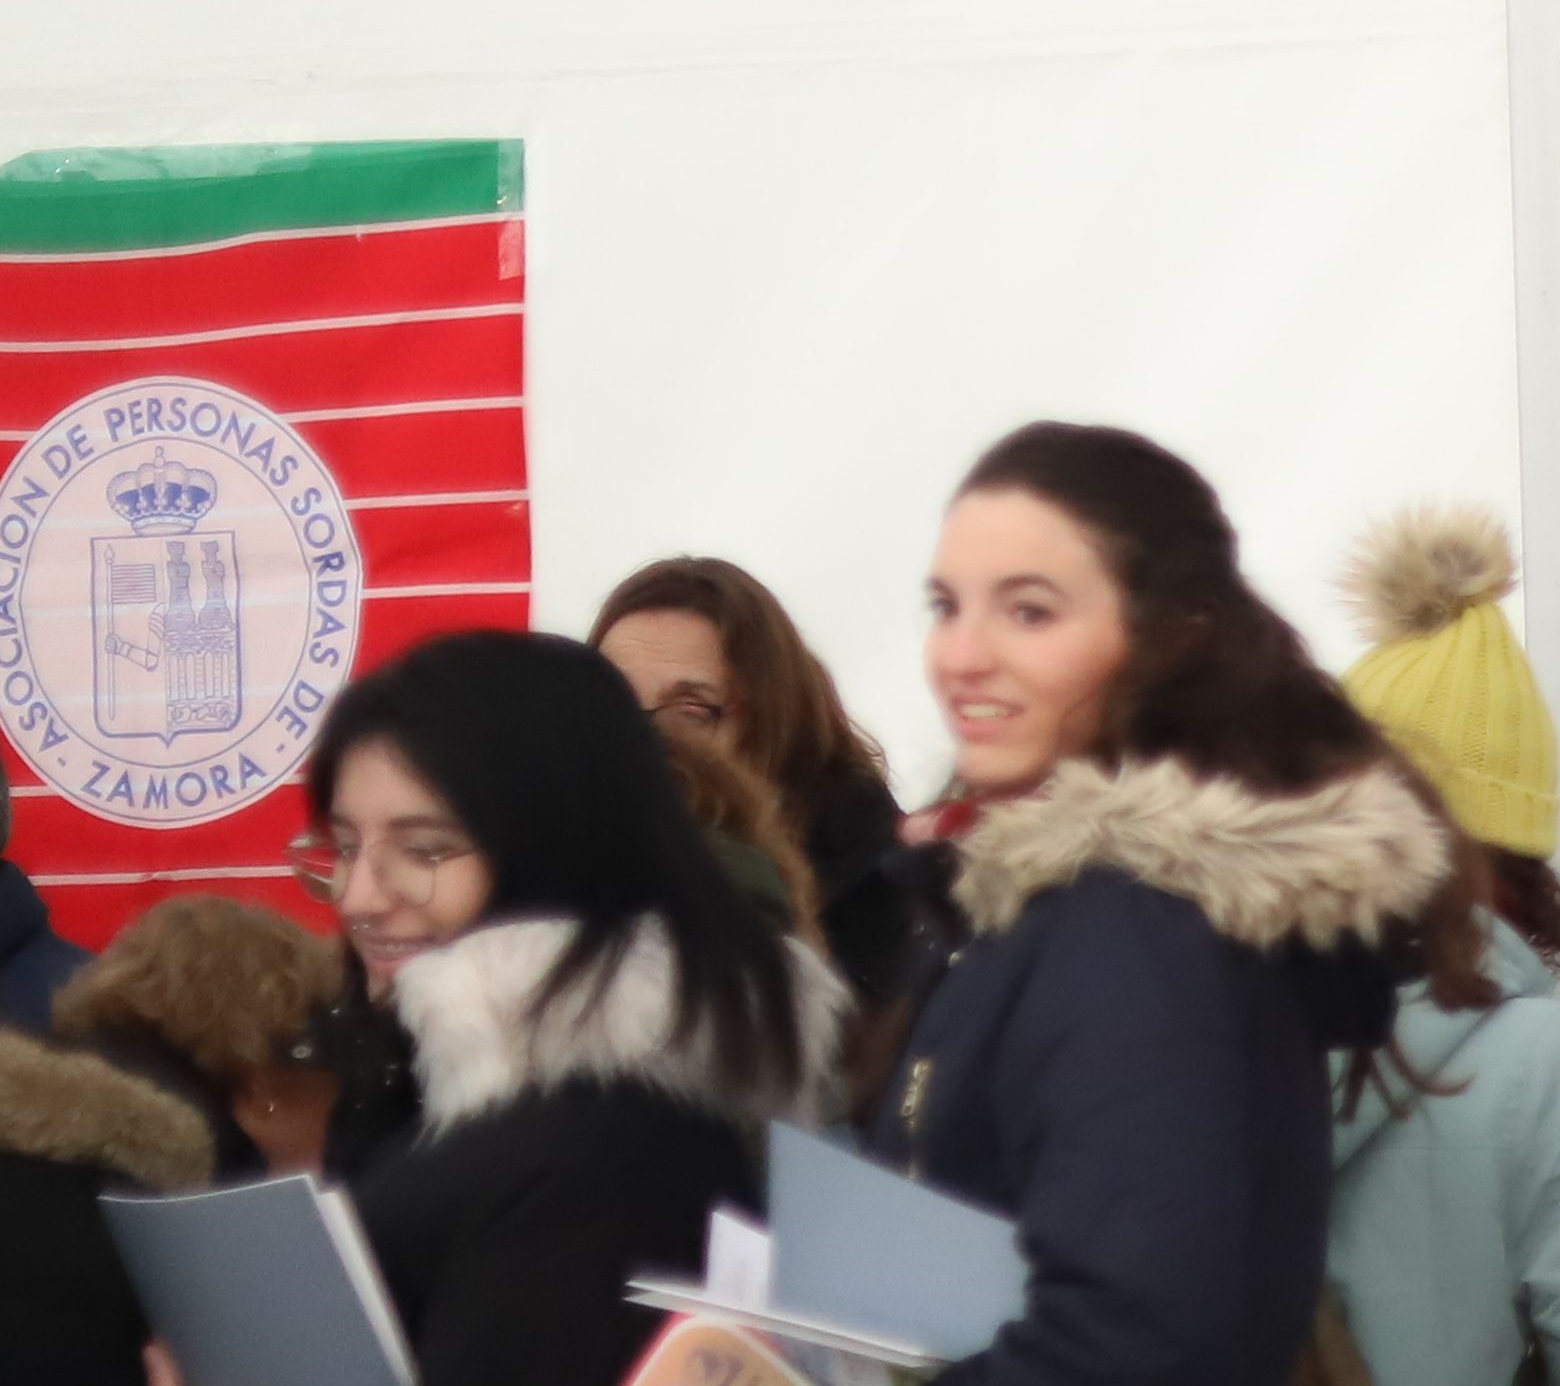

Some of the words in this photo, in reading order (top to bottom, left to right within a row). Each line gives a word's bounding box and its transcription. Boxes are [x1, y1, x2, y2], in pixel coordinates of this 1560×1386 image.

[43, 423, 94, 480] DE
[103, 397, 298, 486] PERSONAS
[291, 487, 347, 669] SORDAS
[275, 679, 325, 738] DE
[81, 752, 266, 809] ZAMORA
